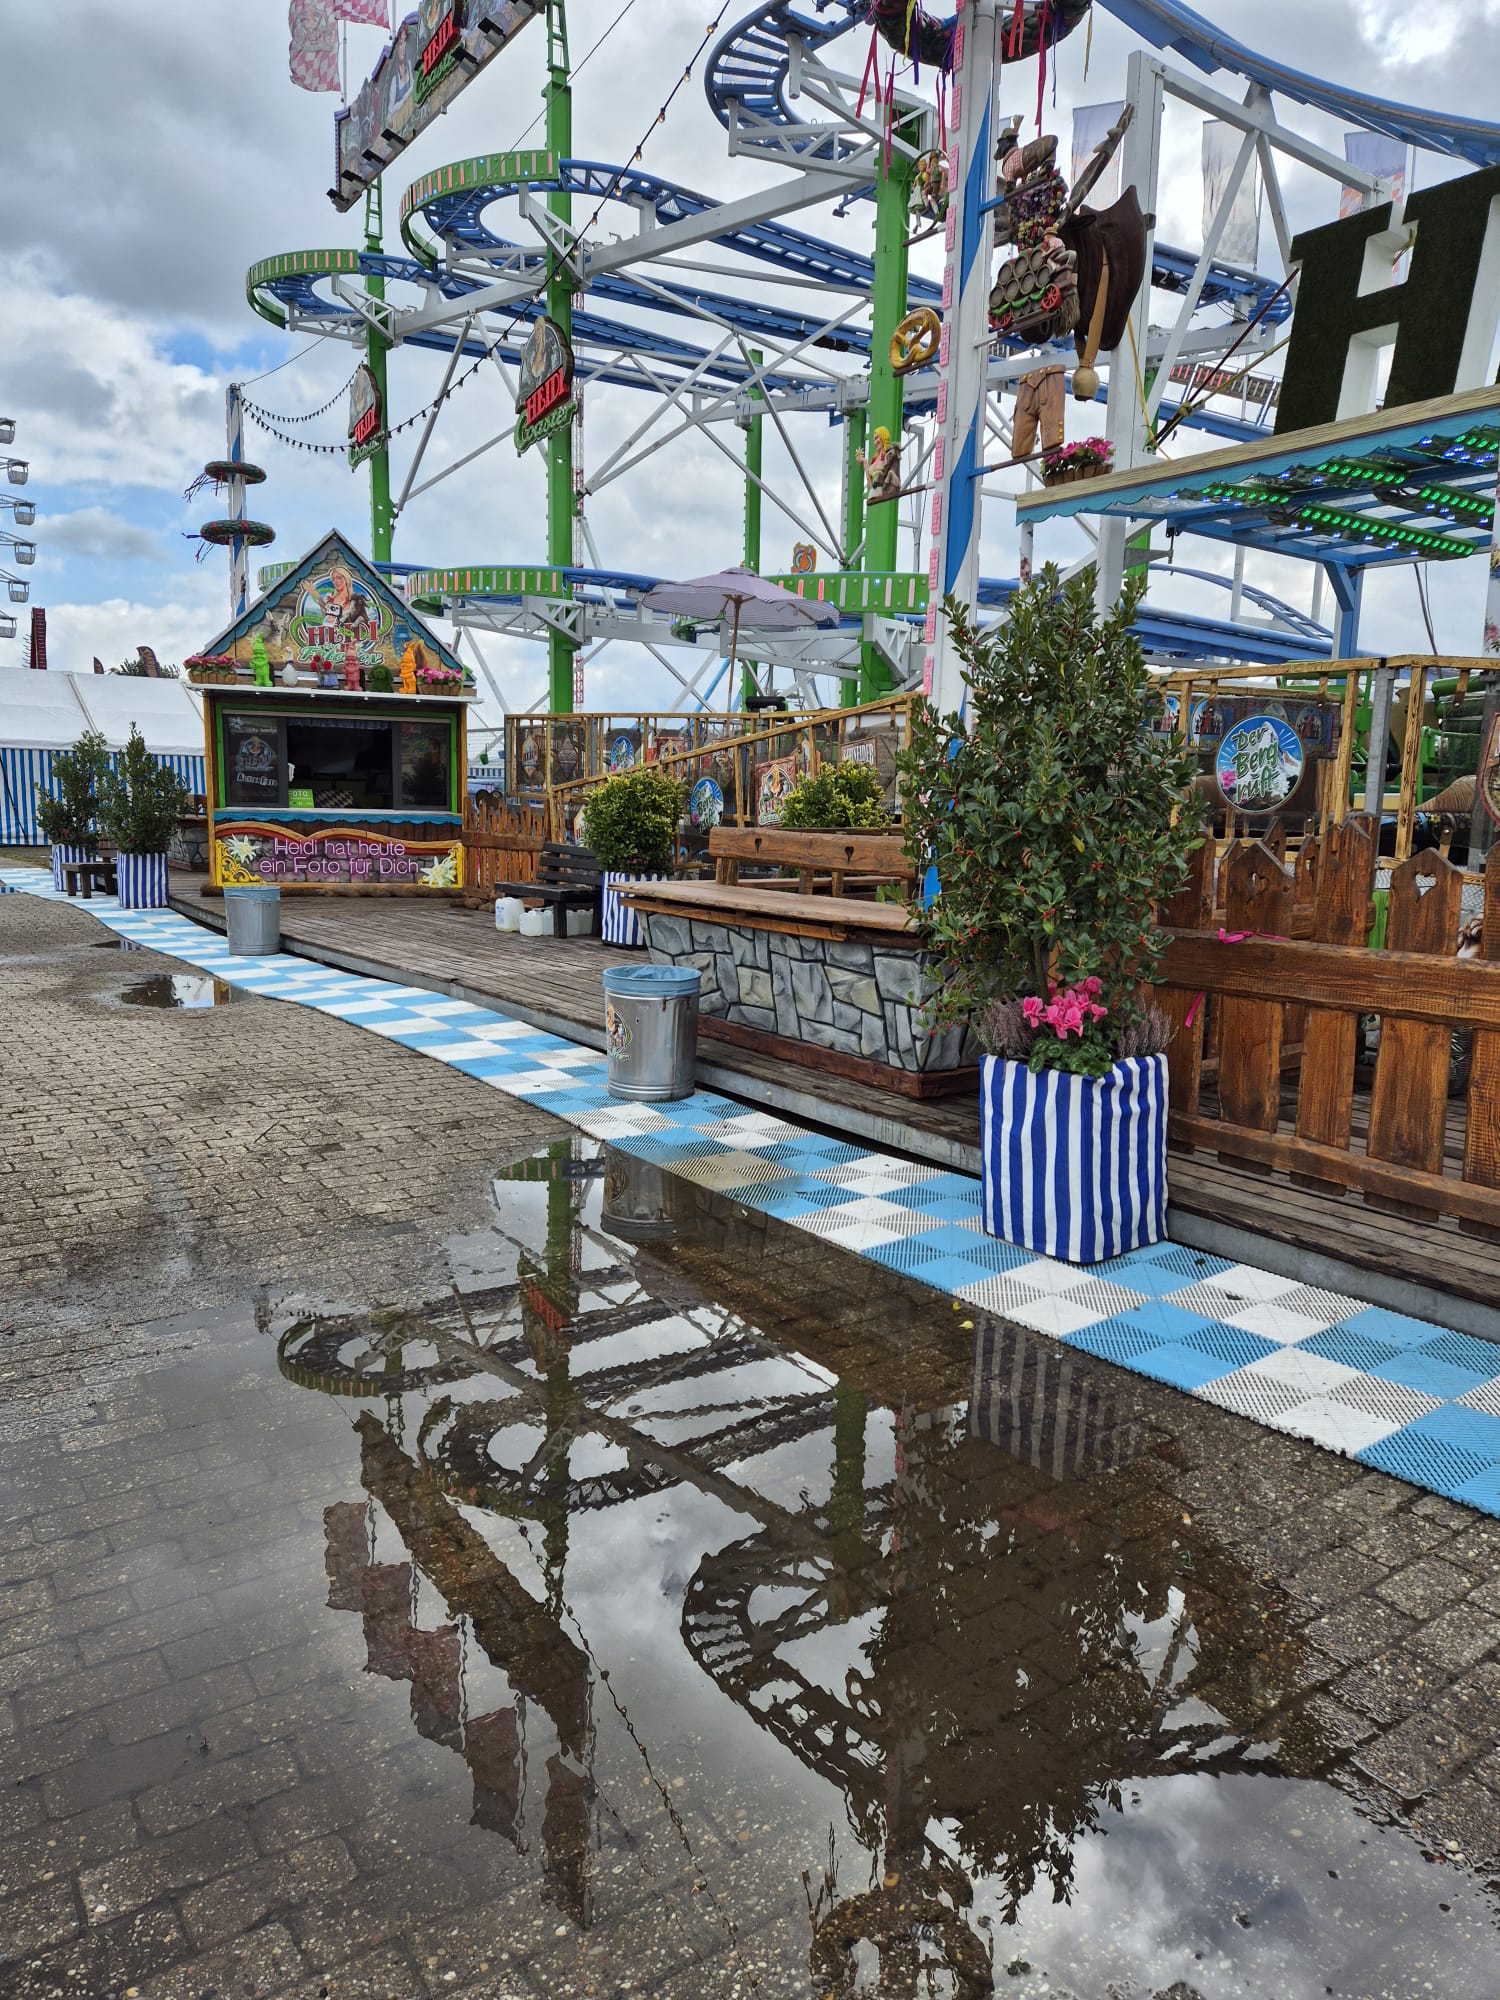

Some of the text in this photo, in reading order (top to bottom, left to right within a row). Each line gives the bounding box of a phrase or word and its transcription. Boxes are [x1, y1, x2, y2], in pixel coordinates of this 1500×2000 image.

[422, 8, 454, 78] HEIDI
[413, 42, 465, 106] Coast
[526, 366, 565, 426] HEIDI
[354, 406, 376, 443] HEIDI
[514, 400, 578, 452] Coaster
[307, 620, 378, 646] HEIDI
[1231, 727, 1270, 752] Der
[1231, 739, 1279, 779] Berg
[1236, 765, 1280, 804] ruft
[259, 856, 419, 874] ein Foto für Dich
[274, 837, 405, 856] Heidi hat heute
